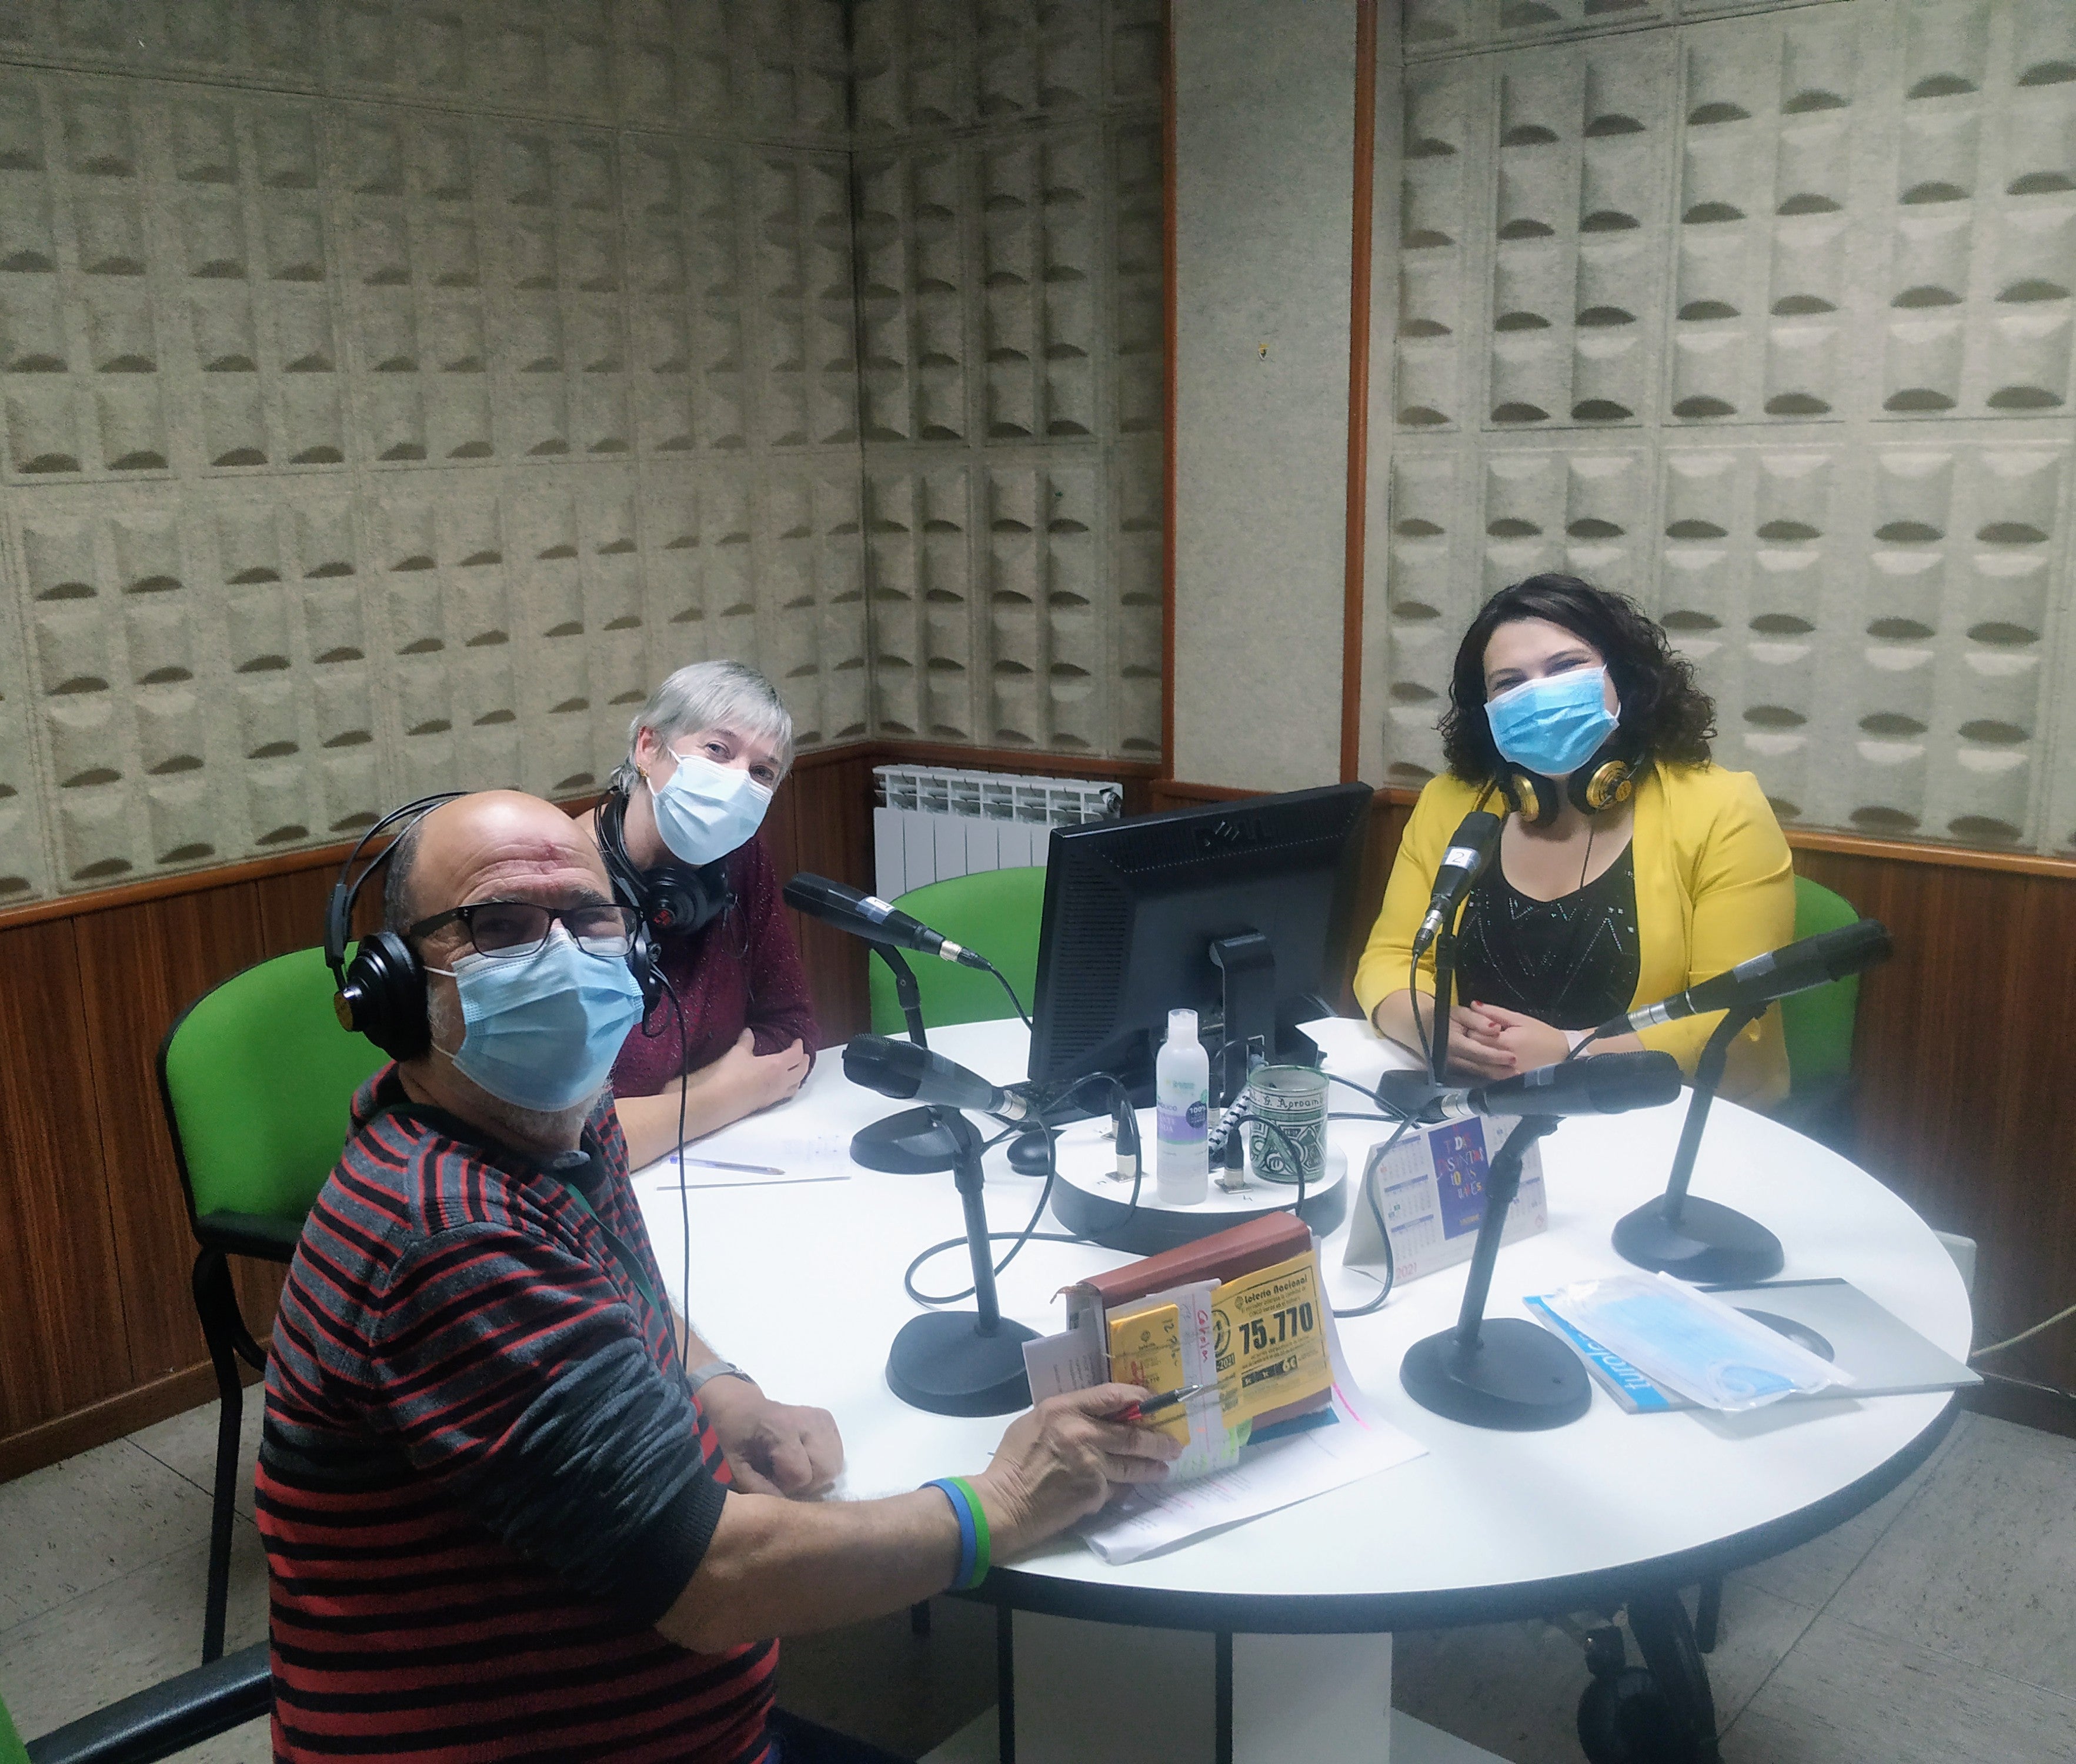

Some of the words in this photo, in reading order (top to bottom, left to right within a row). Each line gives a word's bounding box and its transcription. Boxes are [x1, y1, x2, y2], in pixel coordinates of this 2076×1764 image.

[1452, 852, 1464, 863] 2
[1189, 1105, 1206, 1115] 100%
[1396, 1262, 1417, 1279] 2021
[1273, 1274, 1307, 1294] Nacional
[1239, 1302, 1314, 1355] 75.770
